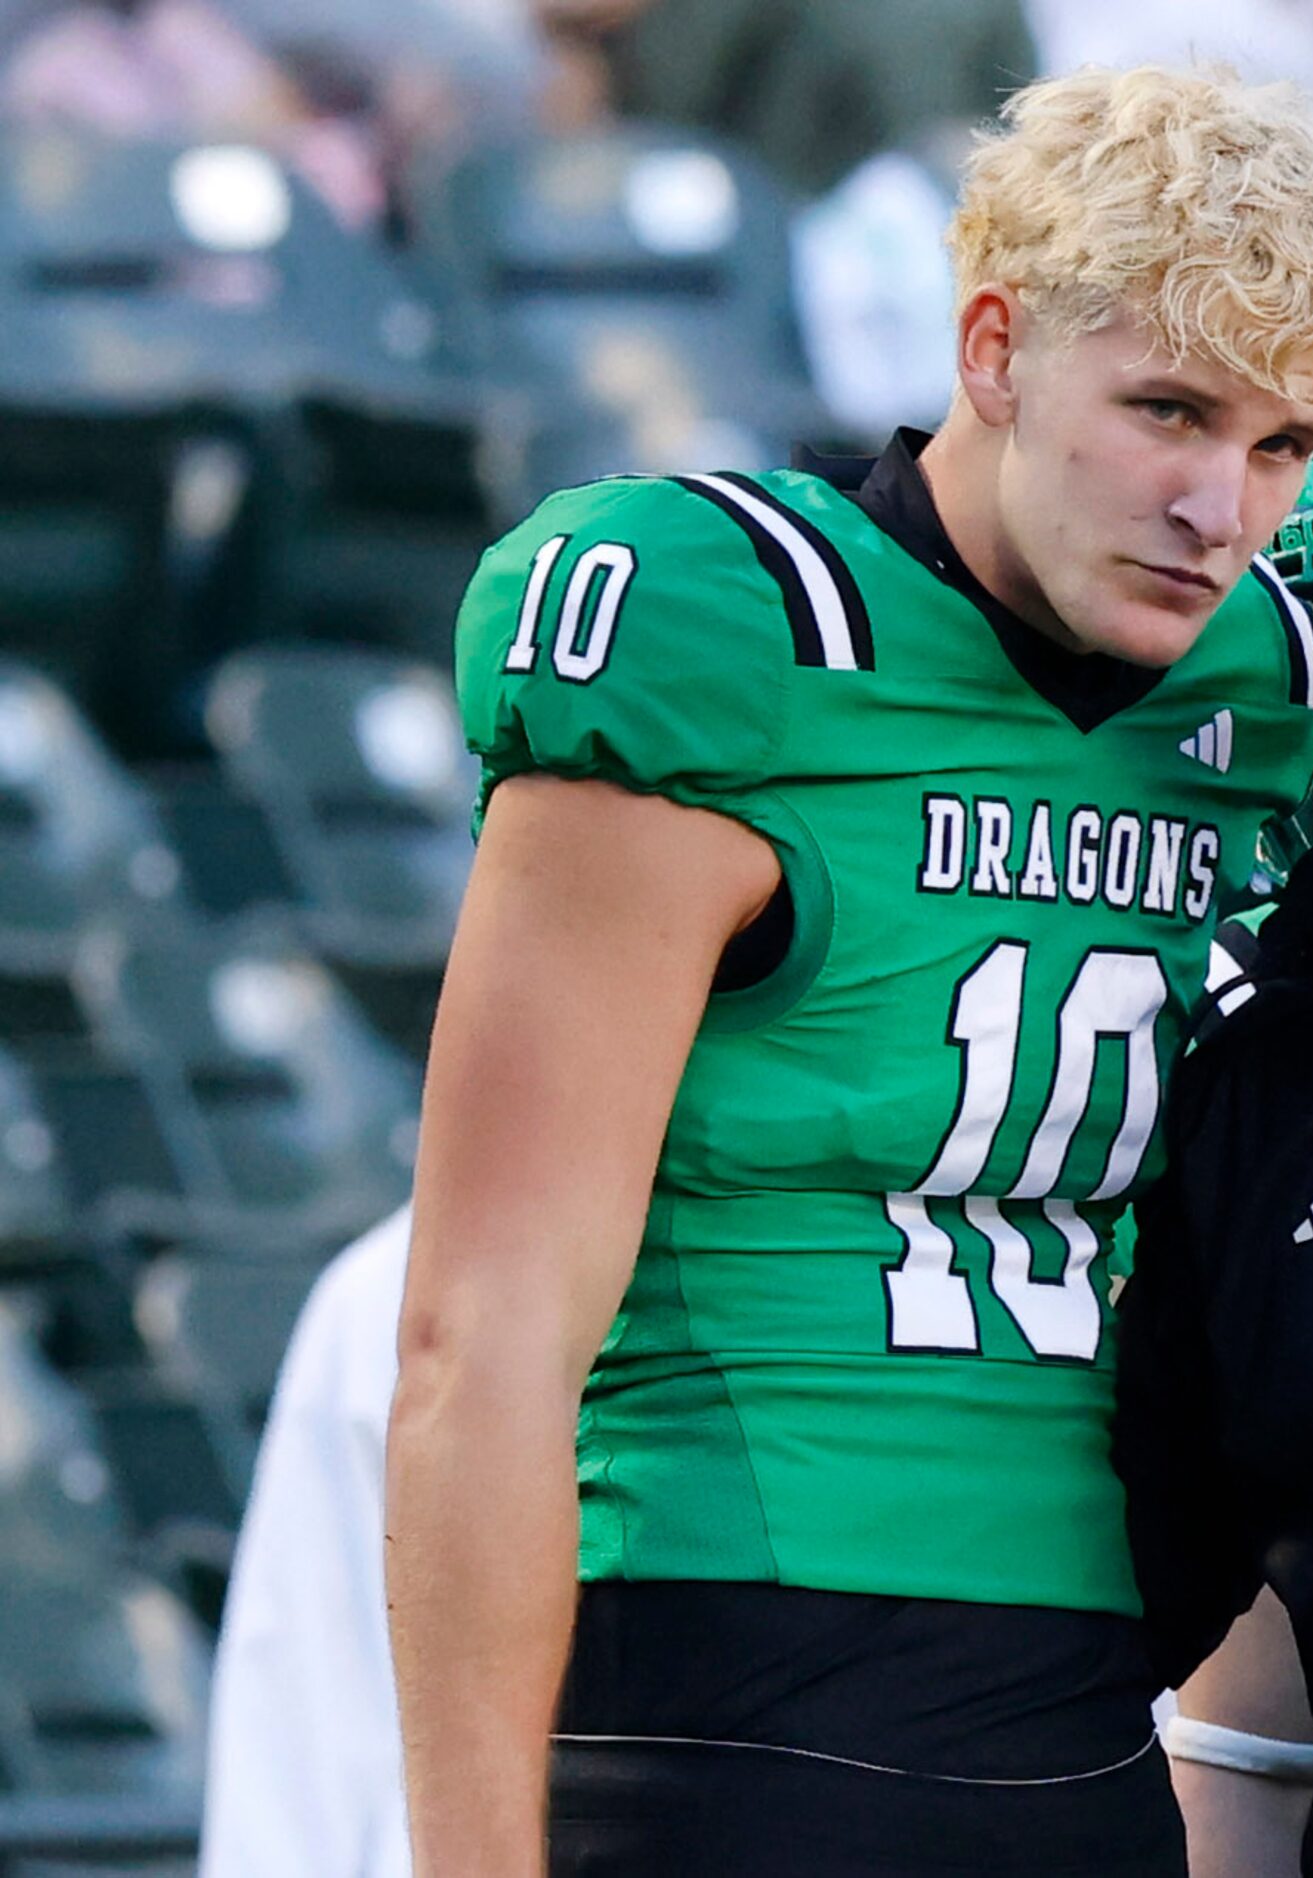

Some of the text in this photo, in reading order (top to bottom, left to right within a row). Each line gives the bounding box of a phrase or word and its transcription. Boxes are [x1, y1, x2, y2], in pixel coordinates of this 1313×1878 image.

[502, 533, 639, 686] 10
[916, 792, 1220, 923] DRAGONS
[880, 936, 1168, 1366] 10
